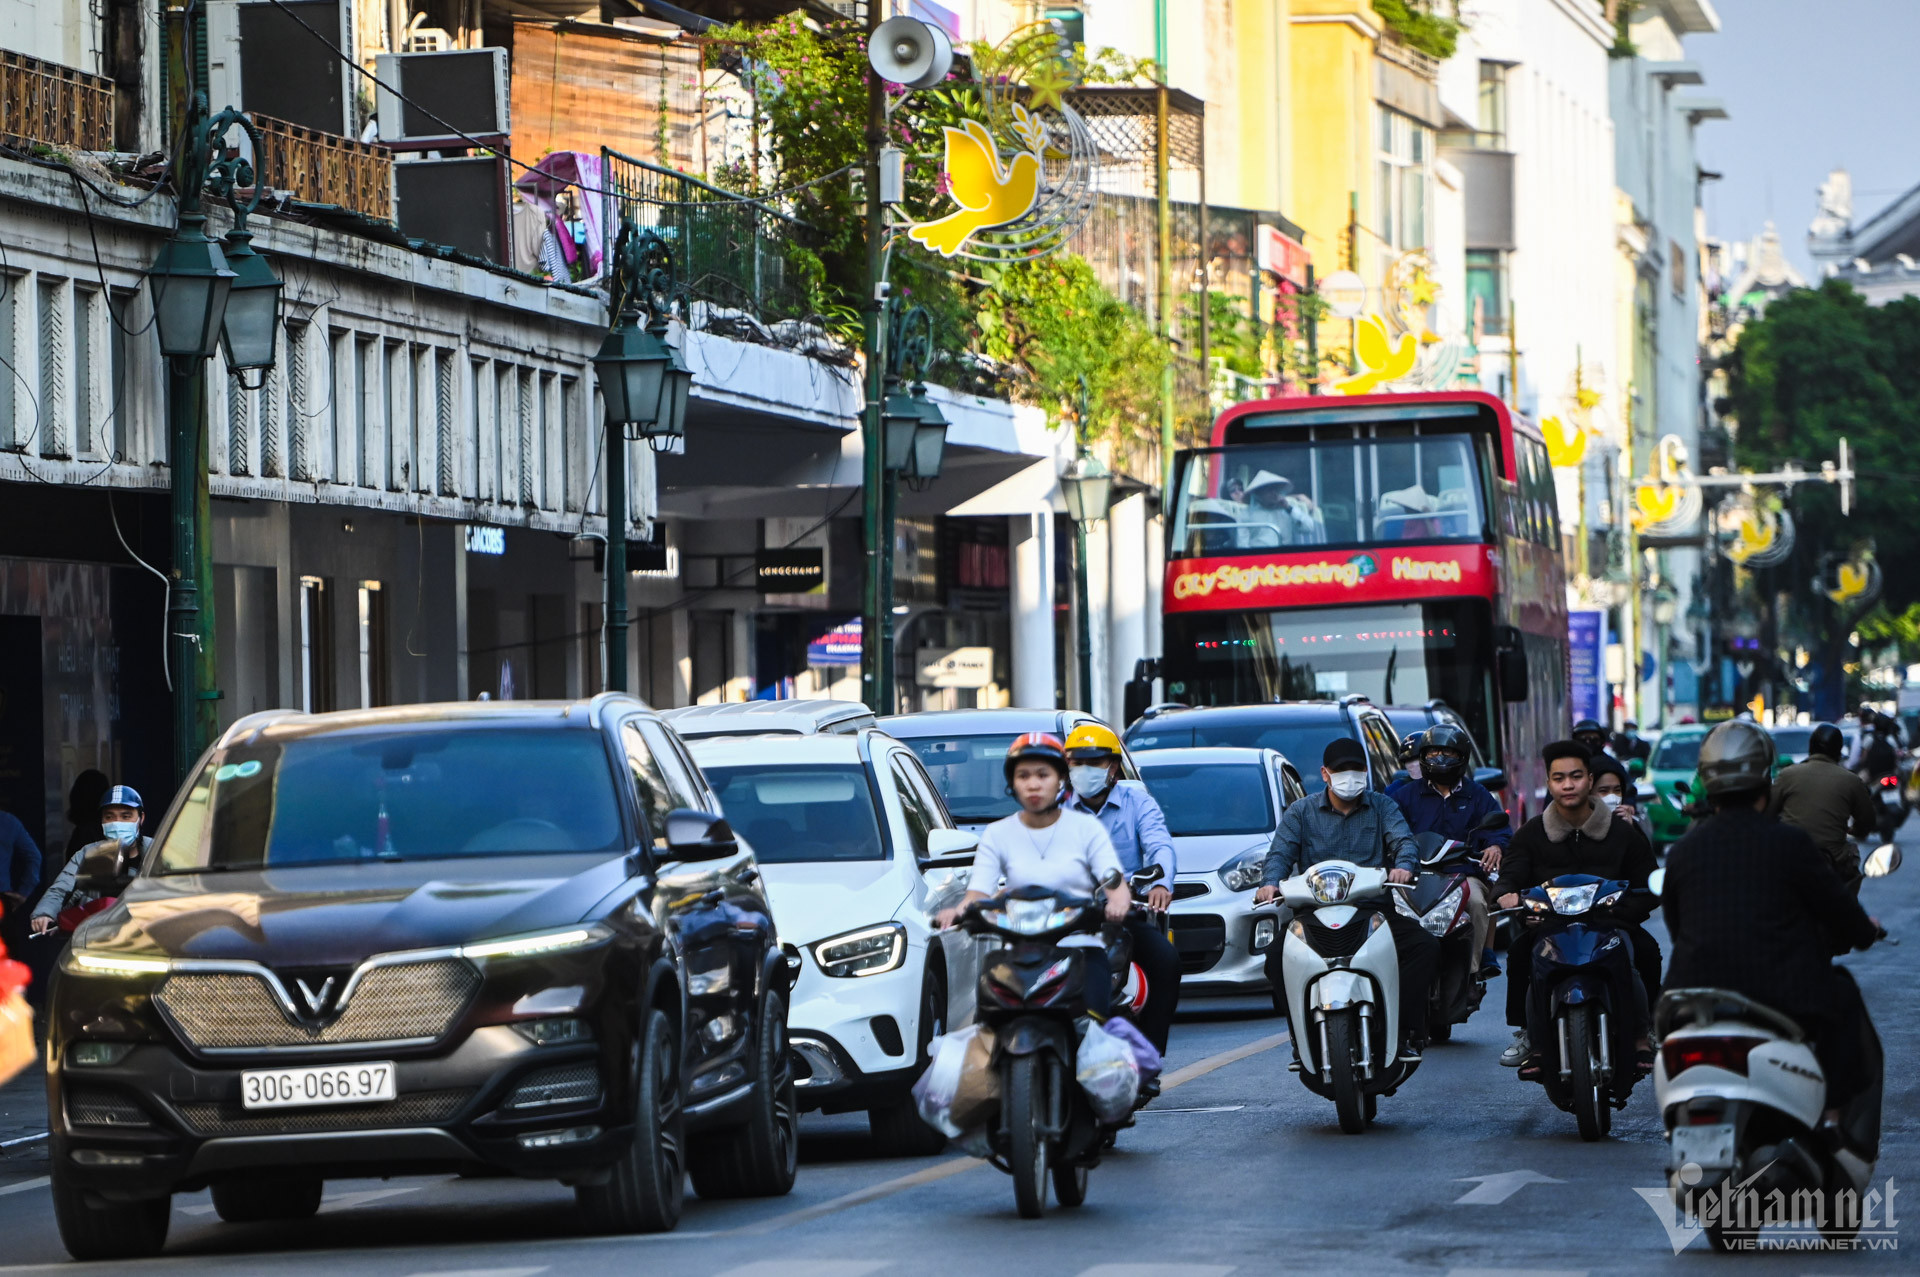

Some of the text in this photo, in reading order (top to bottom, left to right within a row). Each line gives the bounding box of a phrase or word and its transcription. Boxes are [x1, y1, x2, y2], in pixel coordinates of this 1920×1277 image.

[471, 525, 505, 555] JACOBS
[759, 565, 821, 577] LONGCHAMP
[1391, 556, 1462, 583] Hanoi
[247, 1068, 387, 1102] 30G-066.97
